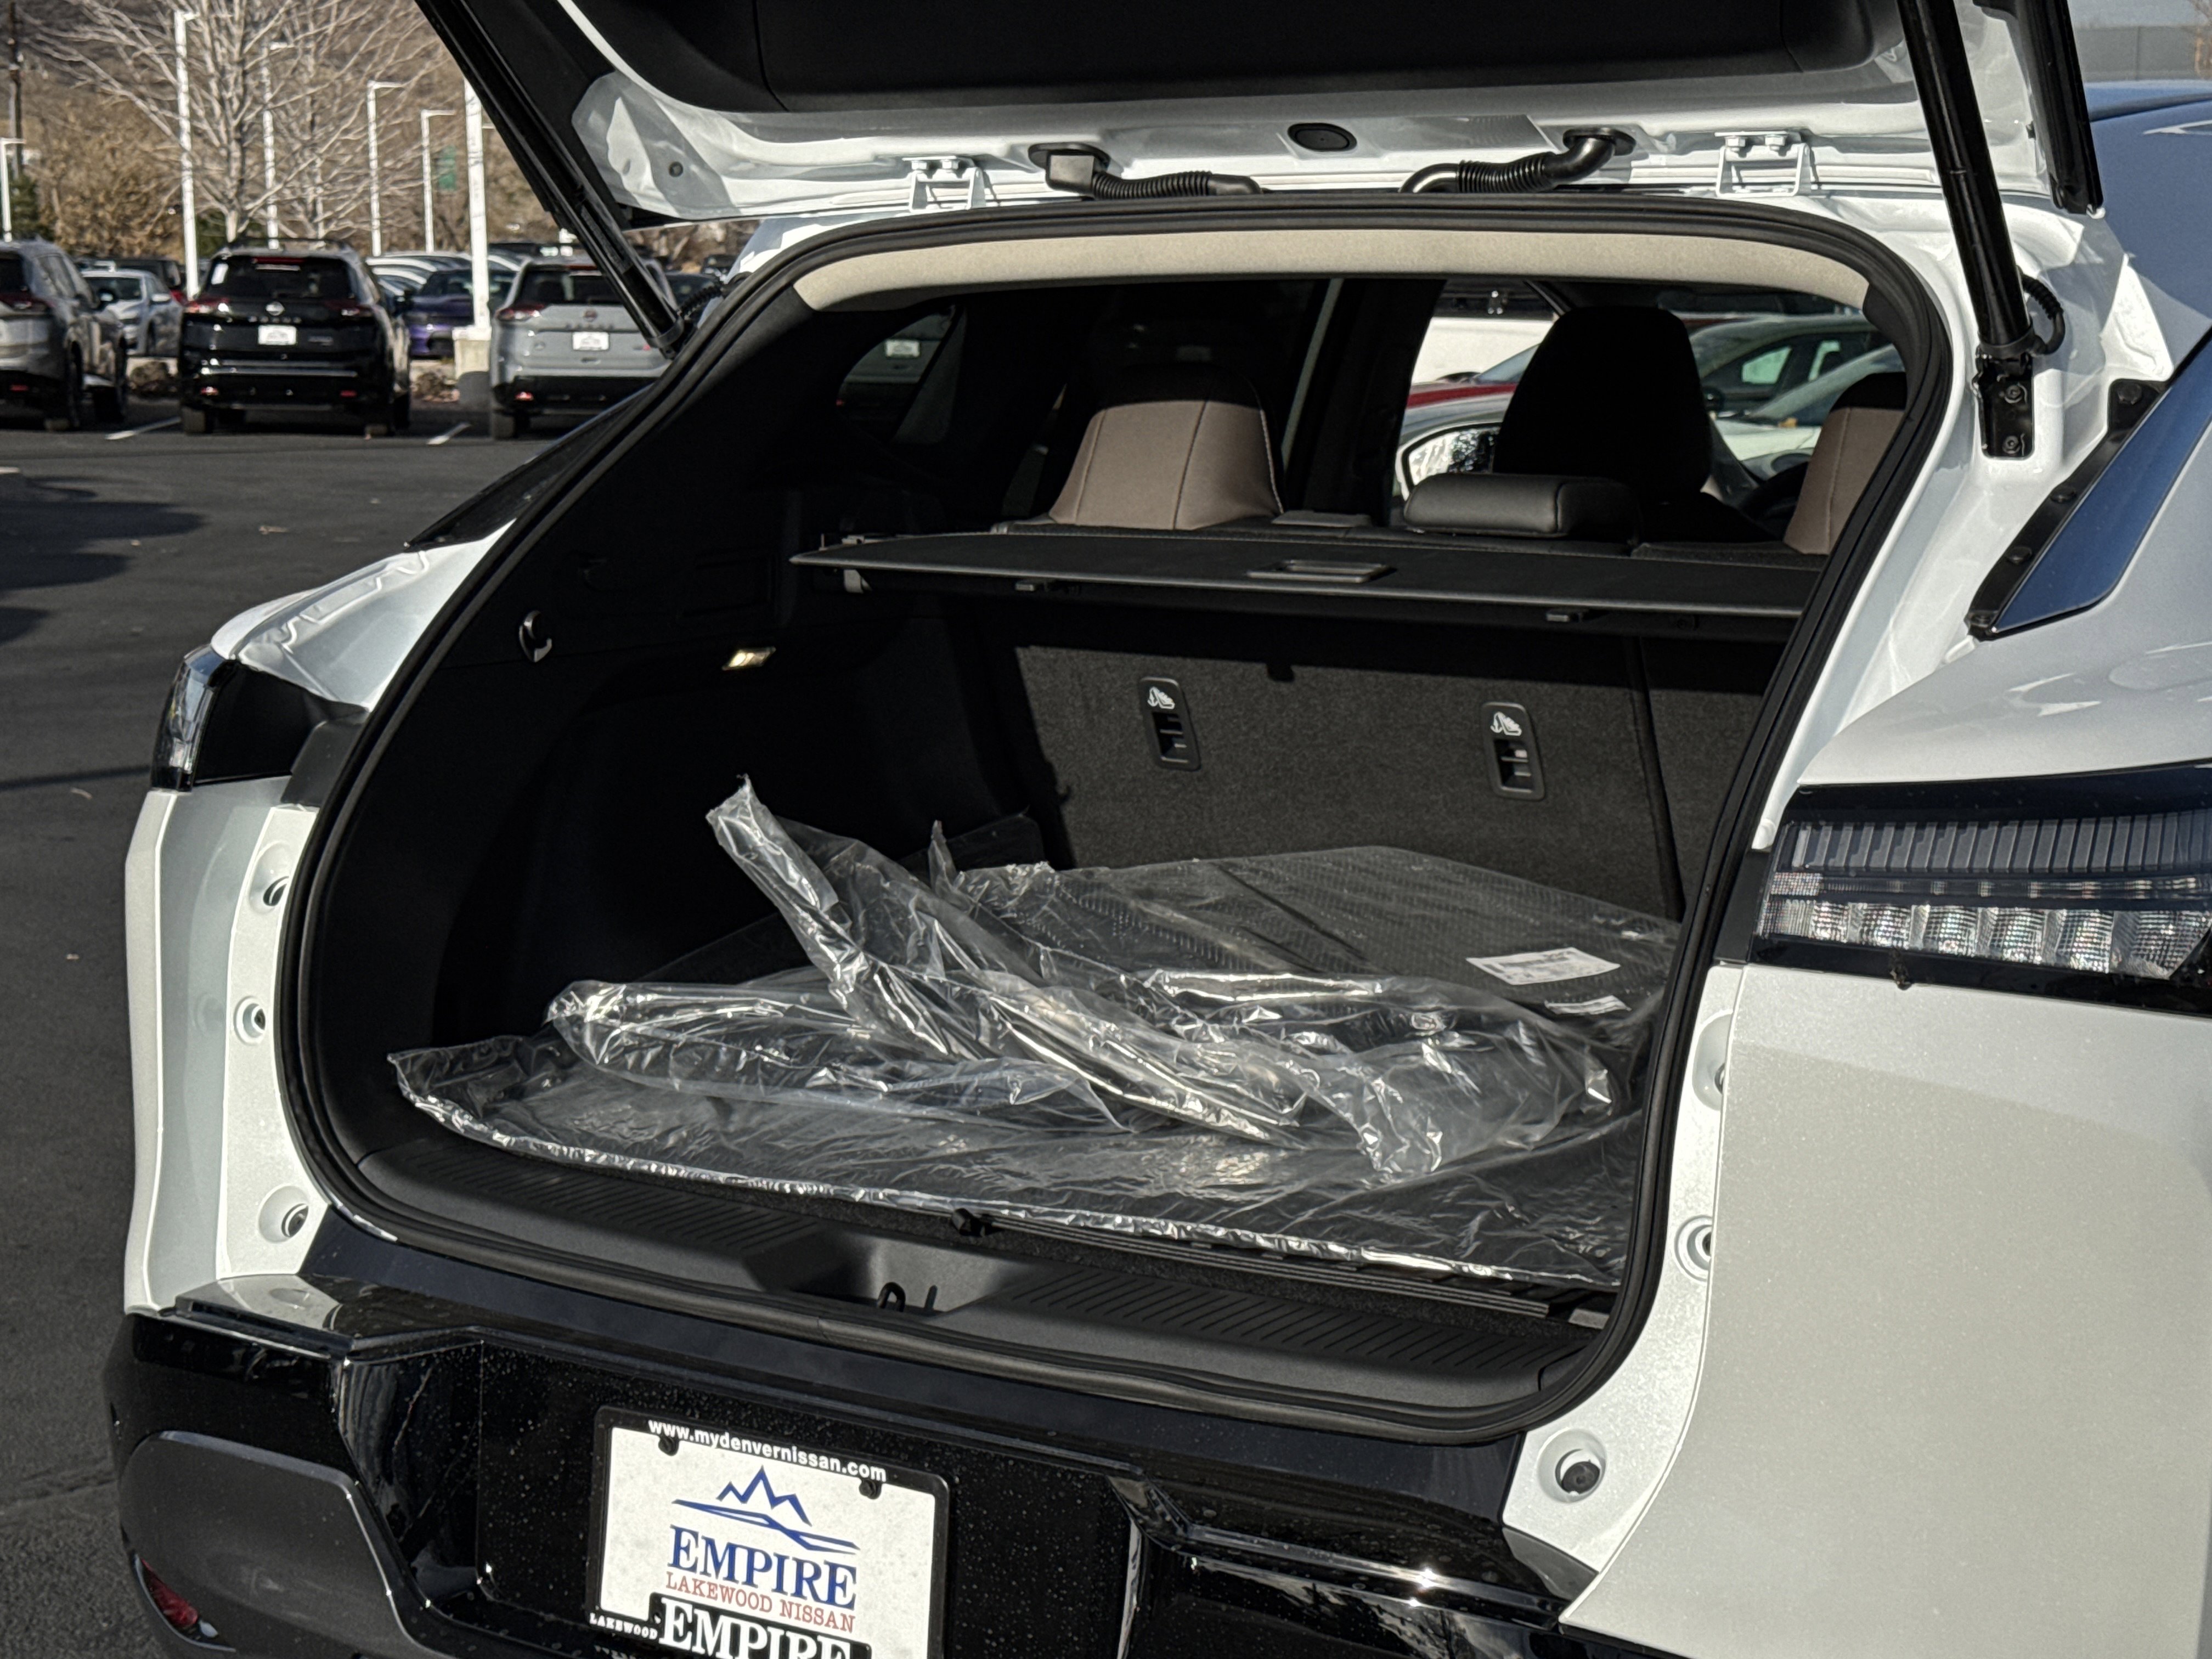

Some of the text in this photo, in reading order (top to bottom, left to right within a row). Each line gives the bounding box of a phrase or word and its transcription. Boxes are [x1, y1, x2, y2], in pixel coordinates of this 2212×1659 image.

[648, 1420, 886, 1482] www.mydenvernissan.com
[667, 1525, 856, 1610] EMPIRE
[590, 1612, 658, 1639] LAKEWOOD
[666, 1571, 855, 1632] LAKEWOOD NISSAN
